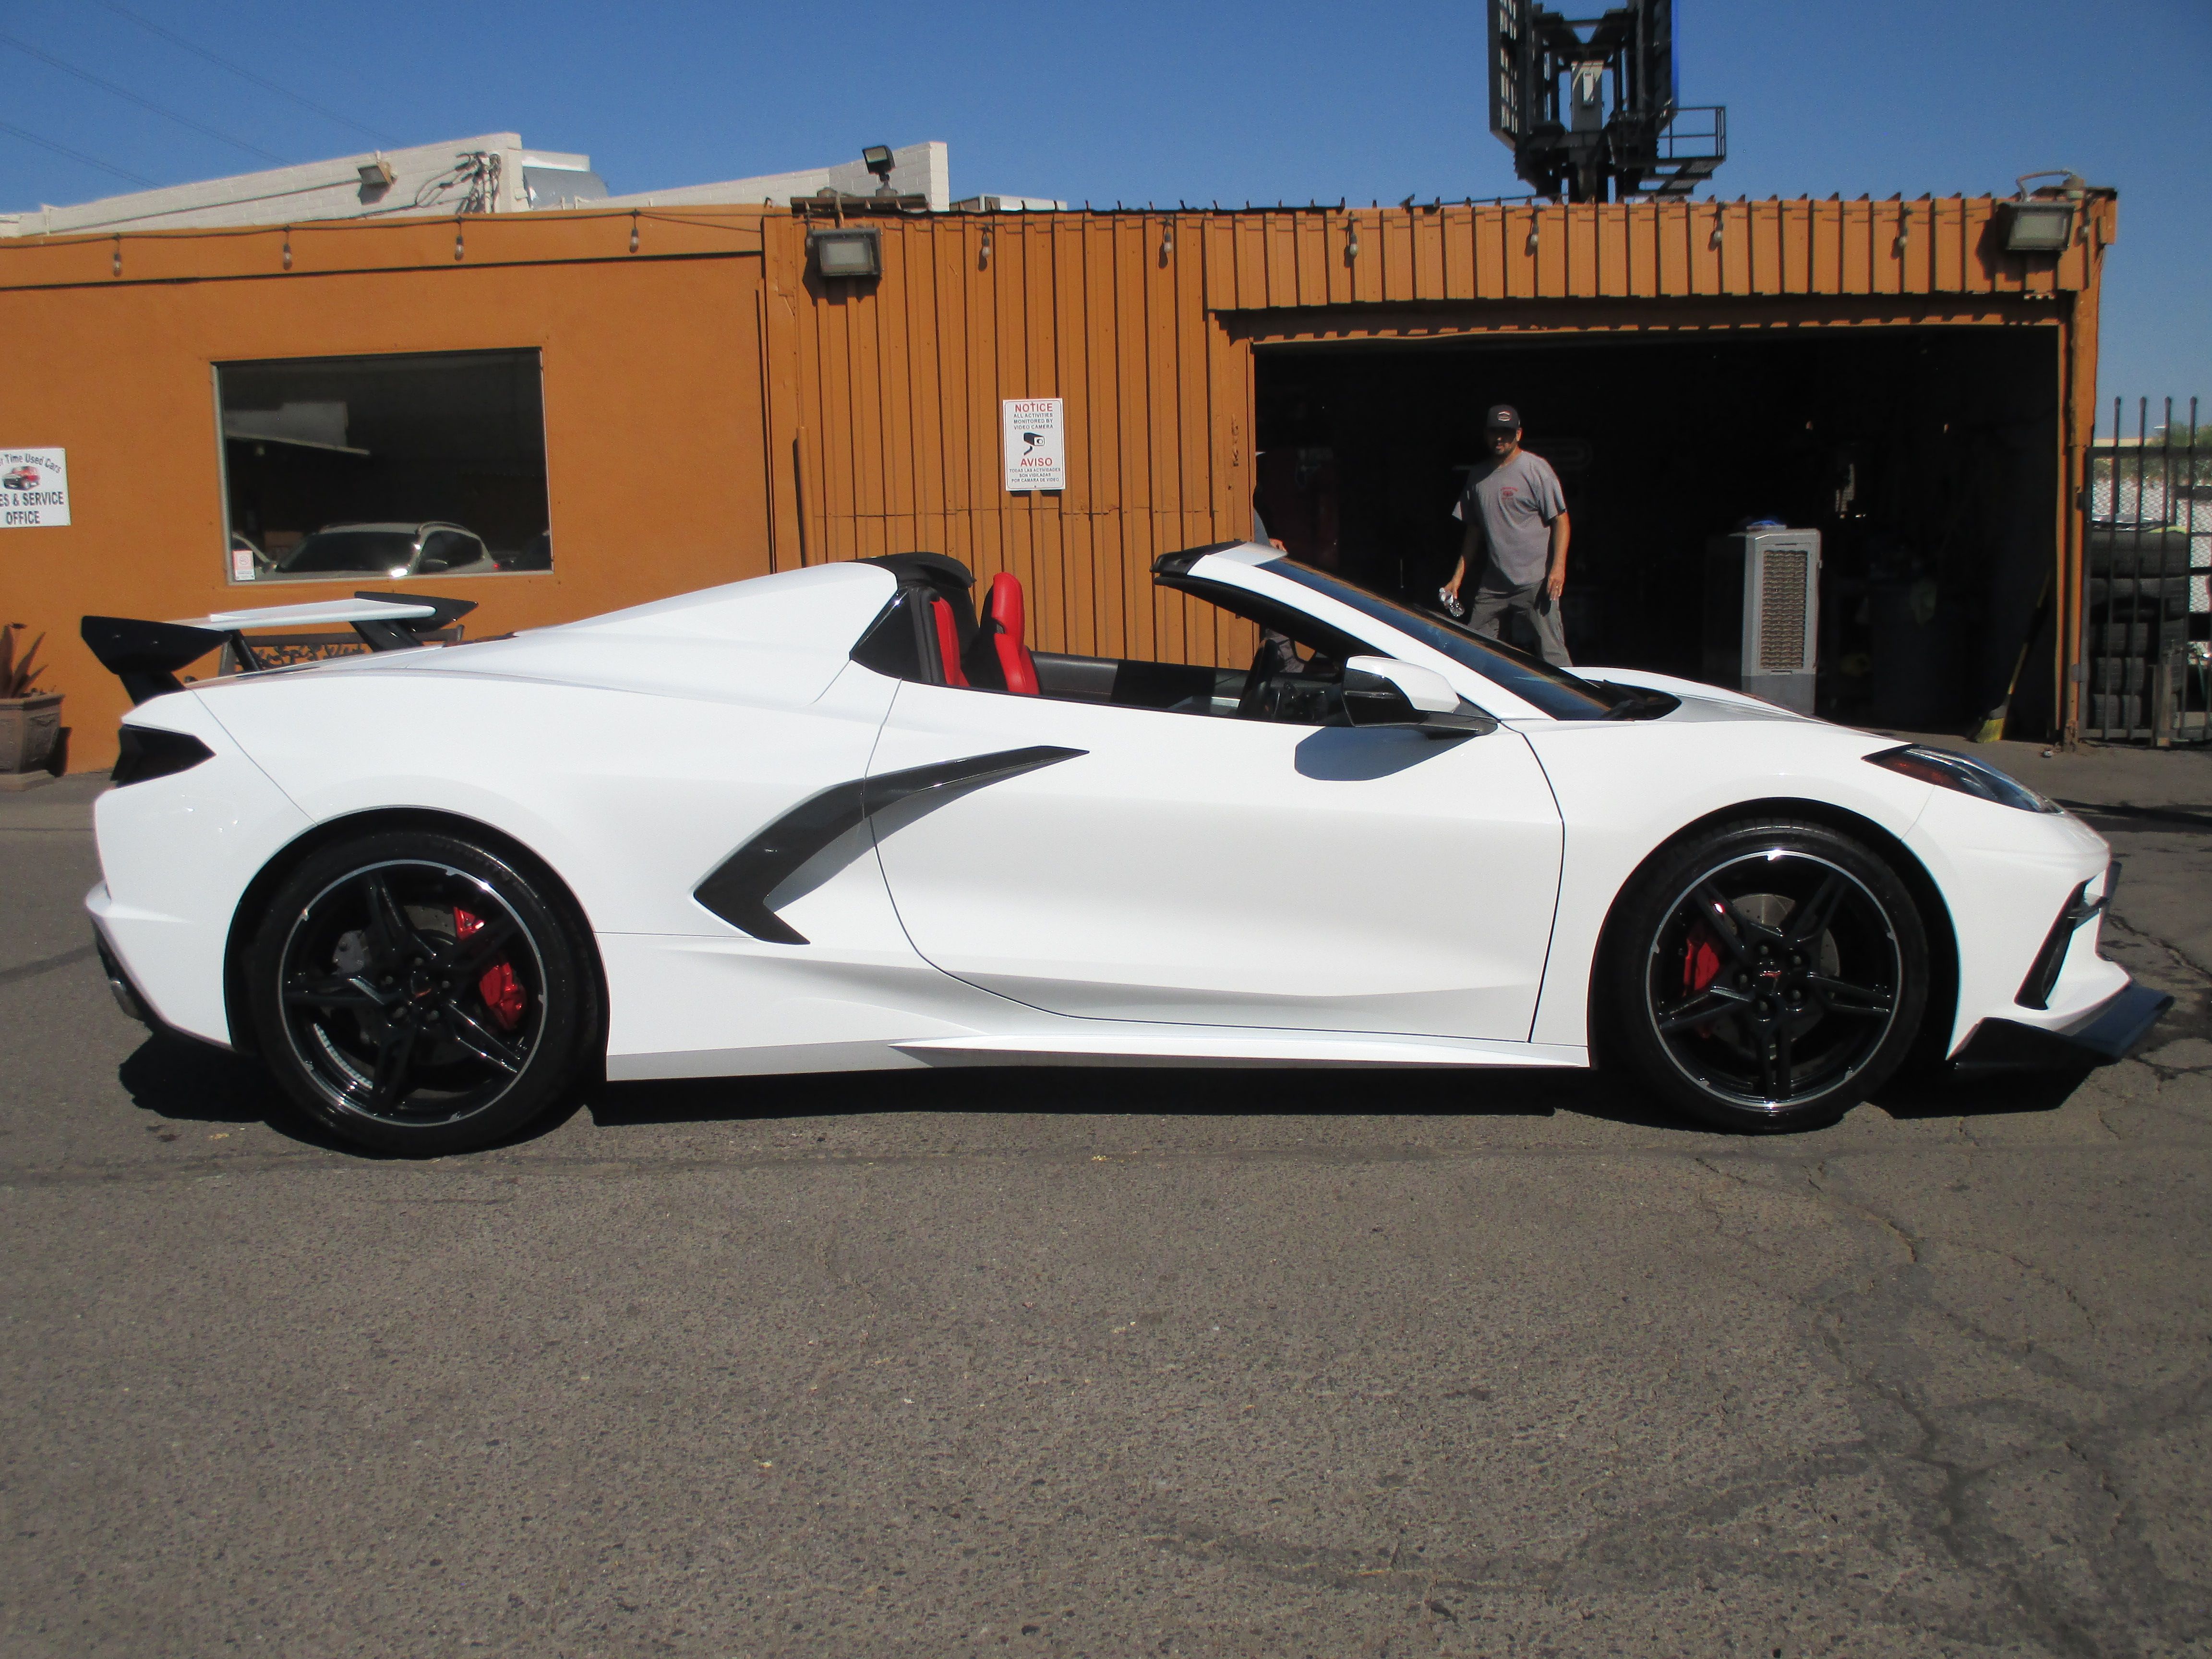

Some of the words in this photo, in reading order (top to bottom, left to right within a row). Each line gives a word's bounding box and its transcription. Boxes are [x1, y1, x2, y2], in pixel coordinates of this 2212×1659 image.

[1015, 403, 1053, 412] NOTICE
[4, 454, 23, 464] Time
[25, 454, 44, 466] Used
[45, 458, 62, 473] Cars
[1020, 457, 1052, 467] AVISO
[13, 493, 20, 506] &
[23, 492, 64, 506] SERVICE
[6, 511, 40, 525] OFFICE
